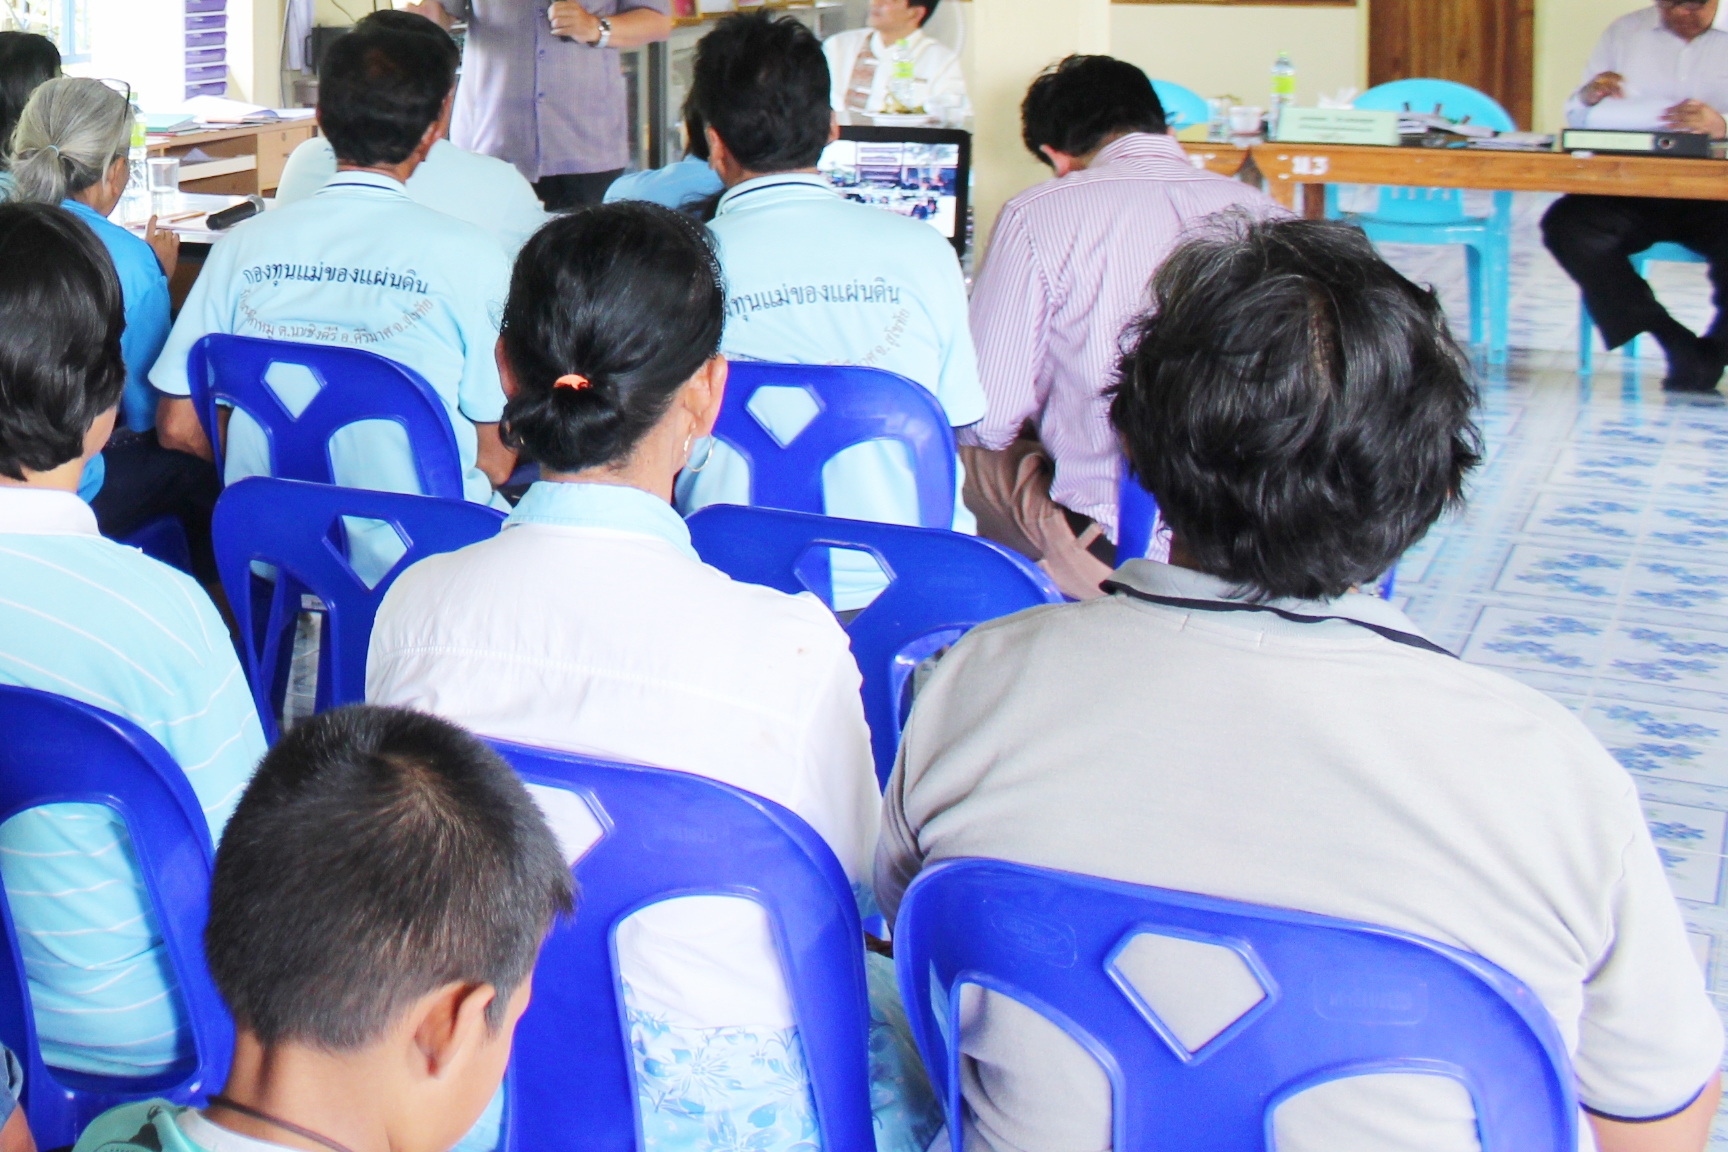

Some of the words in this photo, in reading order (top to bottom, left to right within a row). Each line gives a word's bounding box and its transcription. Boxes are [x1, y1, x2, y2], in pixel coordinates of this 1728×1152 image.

[243, 261, 429, 294] กองทุนแม่ของแผ่นดิน
